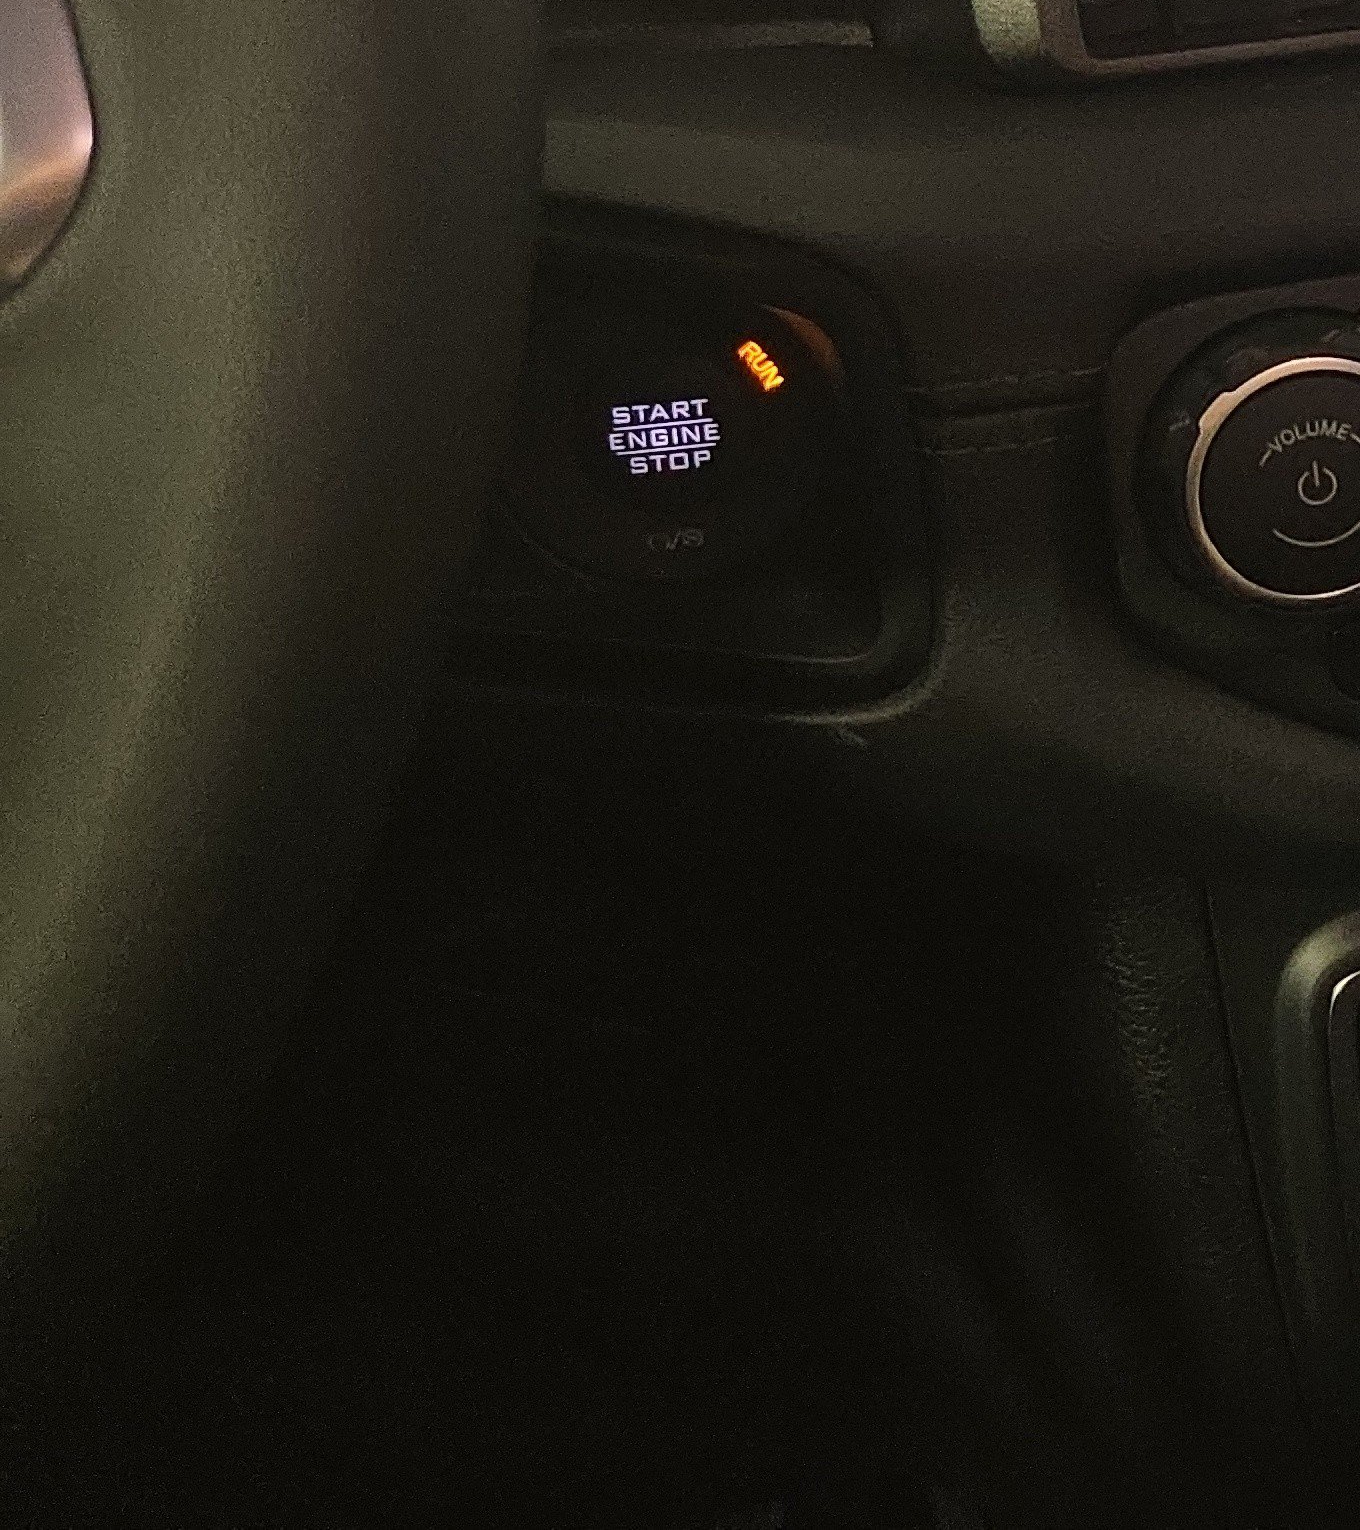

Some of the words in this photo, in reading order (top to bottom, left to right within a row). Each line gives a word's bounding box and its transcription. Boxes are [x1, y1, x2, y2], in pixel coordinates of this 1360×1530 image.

[737, 340, 785, 392] RUN
[611, 398, 709, 425] START
[608, 422, 721, 451] ENGINE
[1268, 417, 1353, 455] VOLUME
[629, 449, 712, 475] STOP
